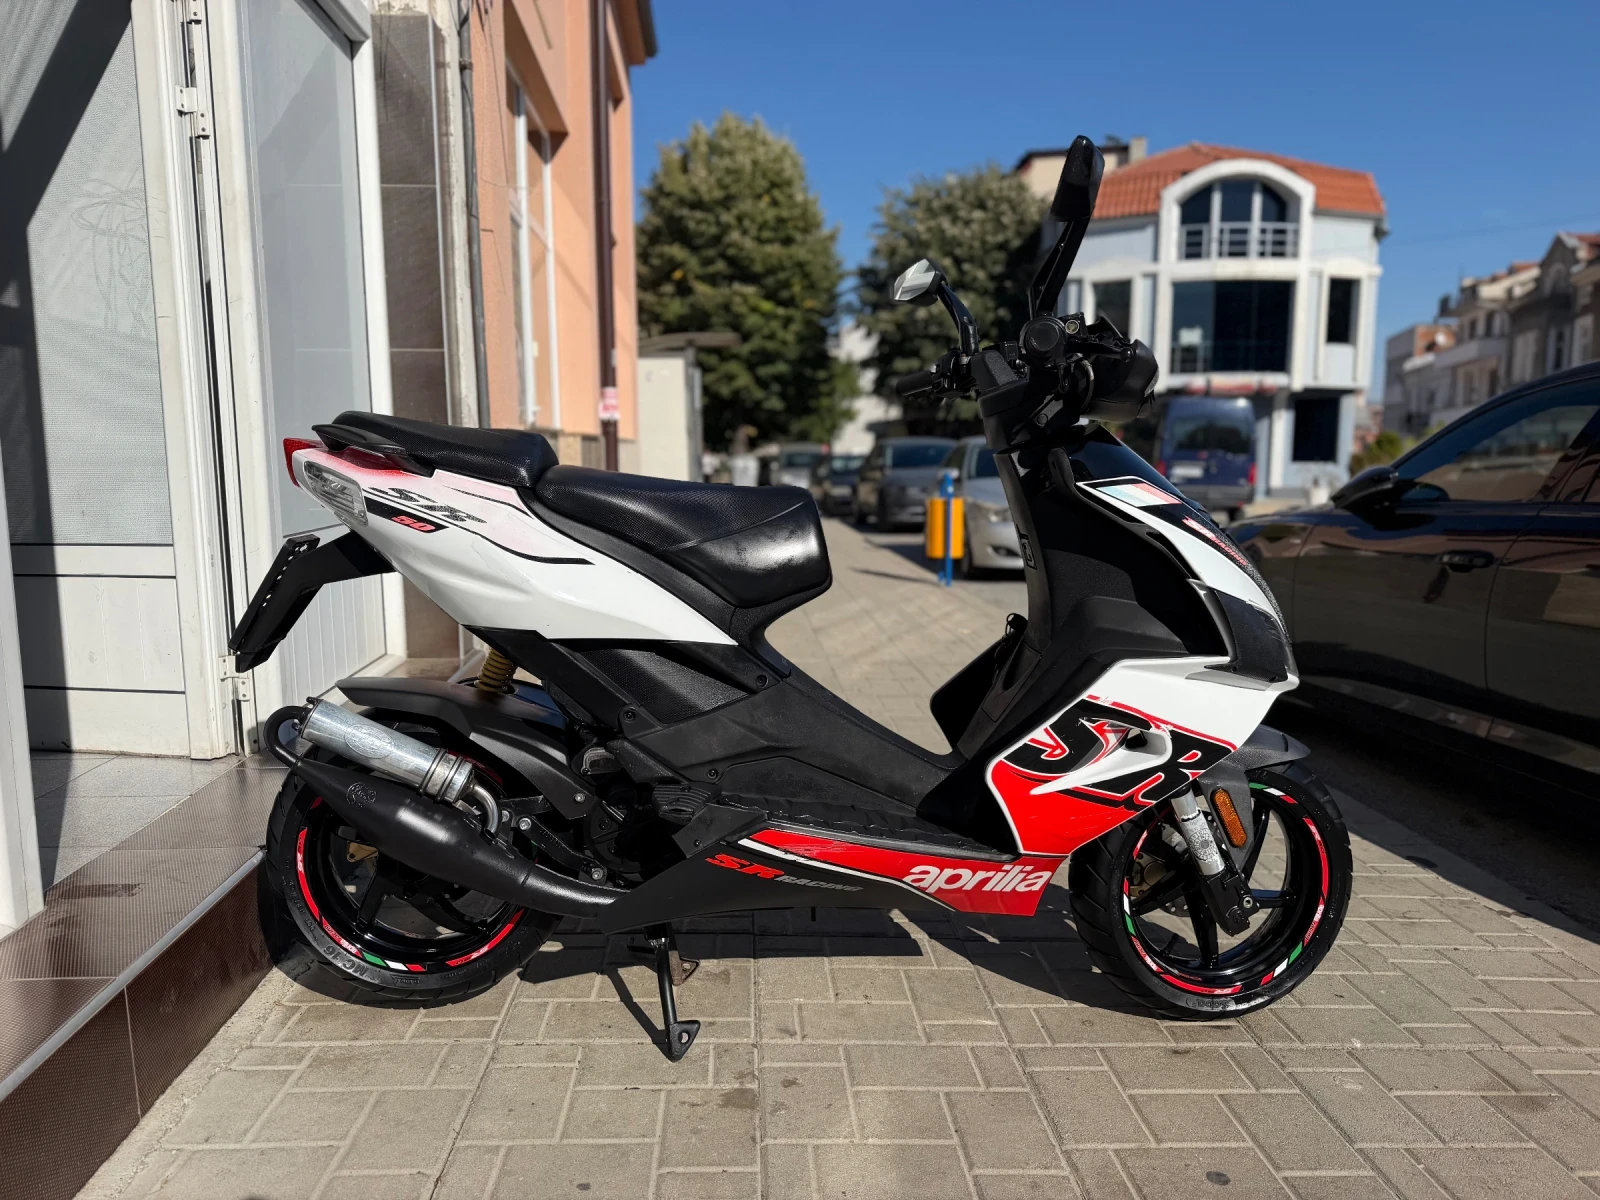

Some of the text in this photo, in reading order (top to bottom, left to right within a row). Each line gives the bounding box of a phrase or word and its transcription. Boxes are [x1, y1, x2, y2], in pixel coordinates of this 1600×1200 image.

[705, 853, 864, 892] SR RACING
[902, 864, 1052, 893] aprilia
[323, 945, 342, 960] 16
